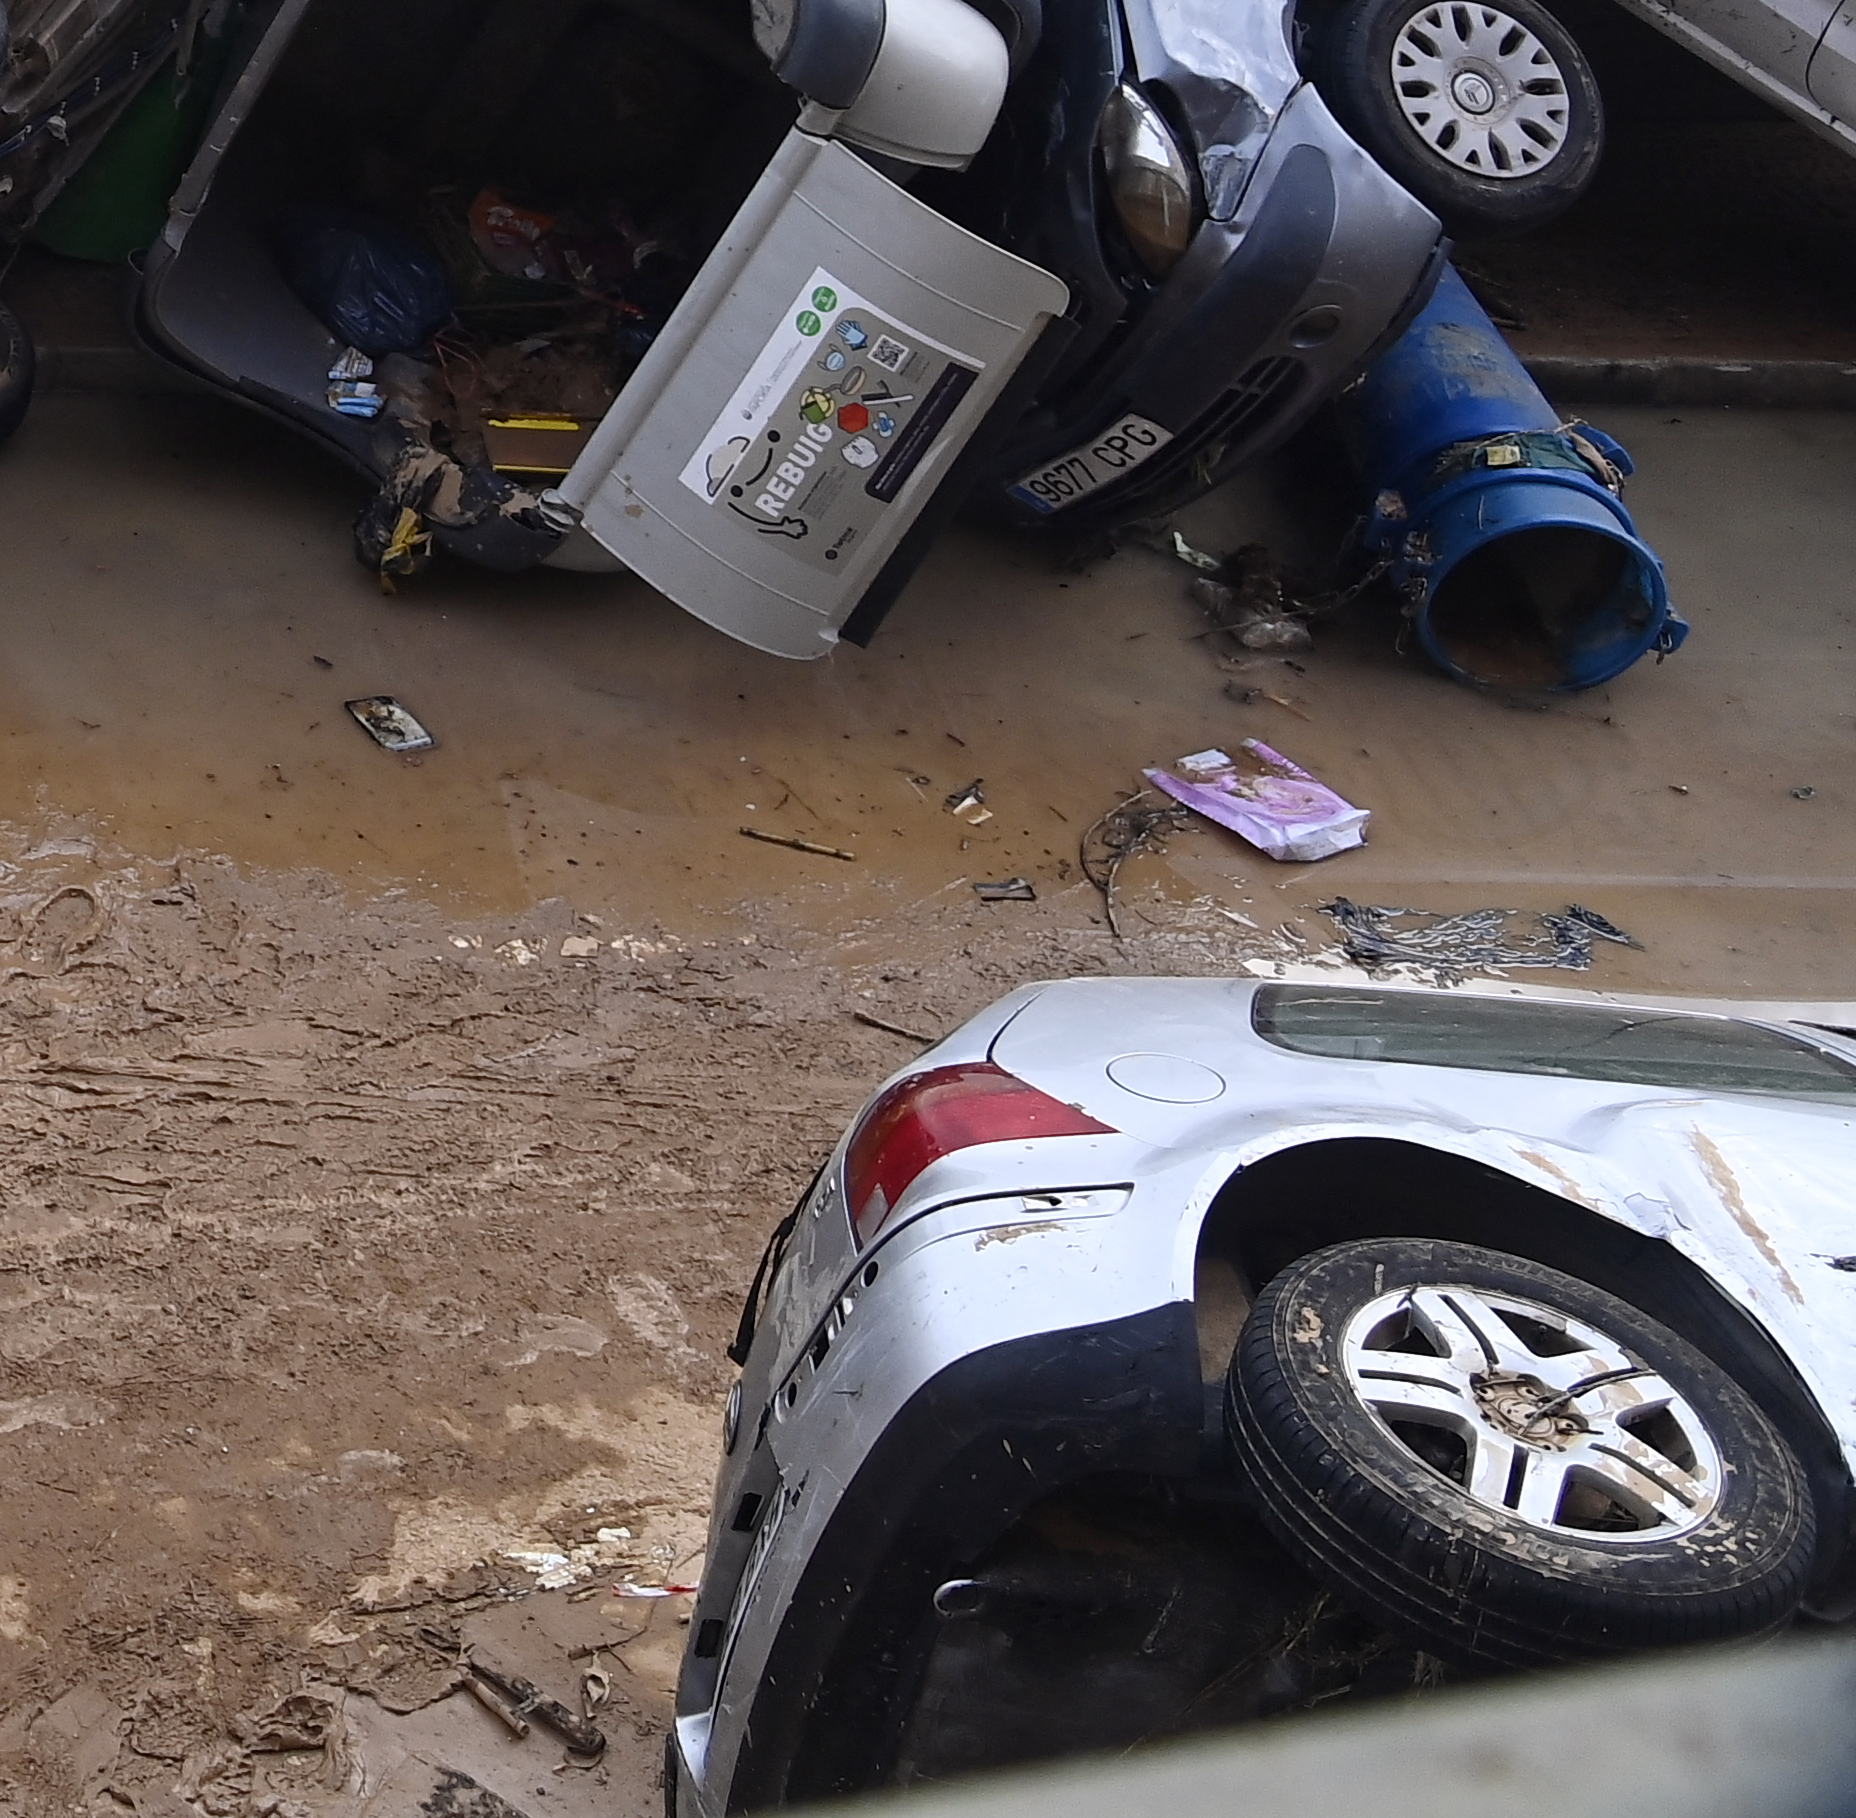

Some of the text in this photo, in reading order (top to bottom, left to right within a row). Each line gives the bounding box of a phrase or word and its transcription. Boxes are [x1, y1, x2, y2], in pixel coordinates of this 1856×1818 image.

[754, 423, 834, 518] REBUIG
[1028, 424, 1158, 502] 9677 CPG
